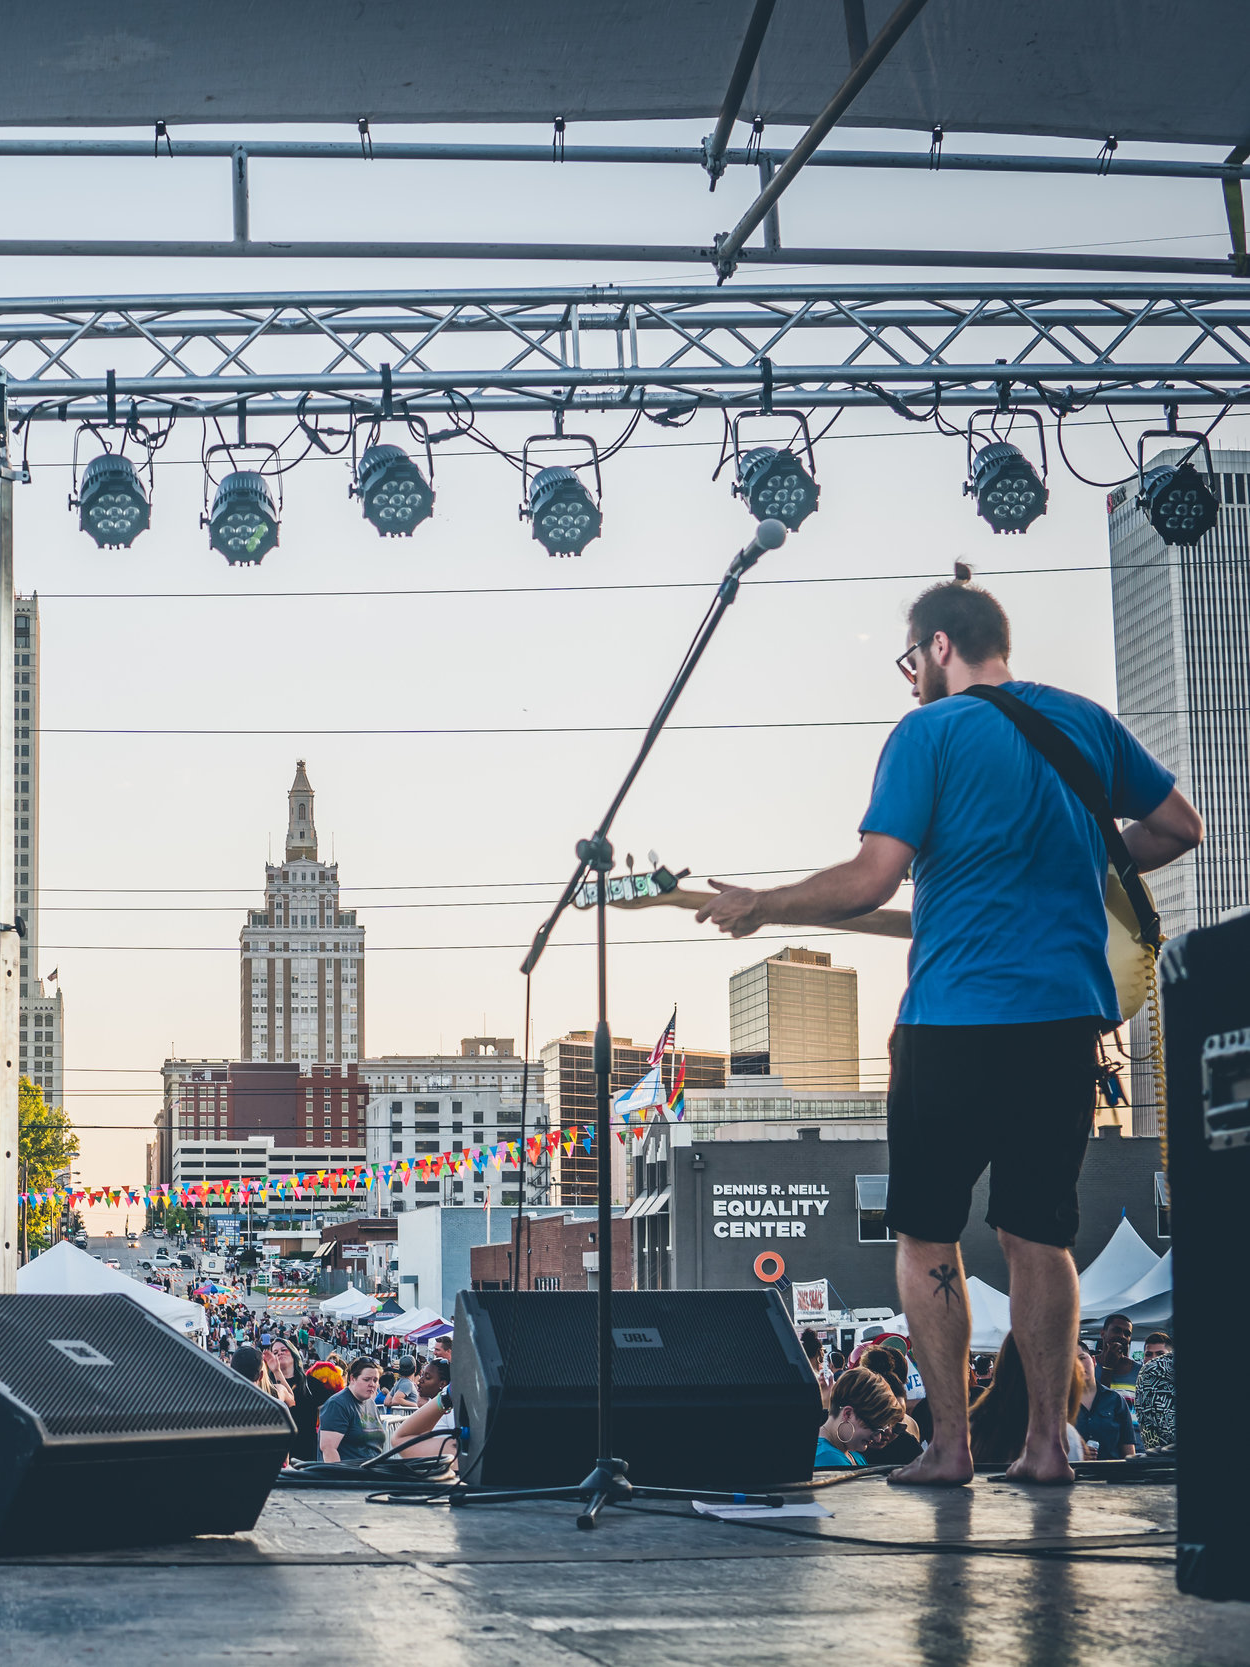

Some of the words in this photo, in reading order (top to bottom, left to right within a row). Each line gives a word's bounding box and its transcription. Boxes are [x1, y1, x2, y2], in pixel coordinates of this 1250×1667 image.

[713, 1184, 767, 1195] DENNIS
[771, 1184, 785, 1195] R.
[788, 1184, 830, 1195] NEILL
[713, 1200, 830, 1217] EQUALITY
[713, 1221, 806, 1238] CENTER
[622, 1333, 654, 1343] JBL
